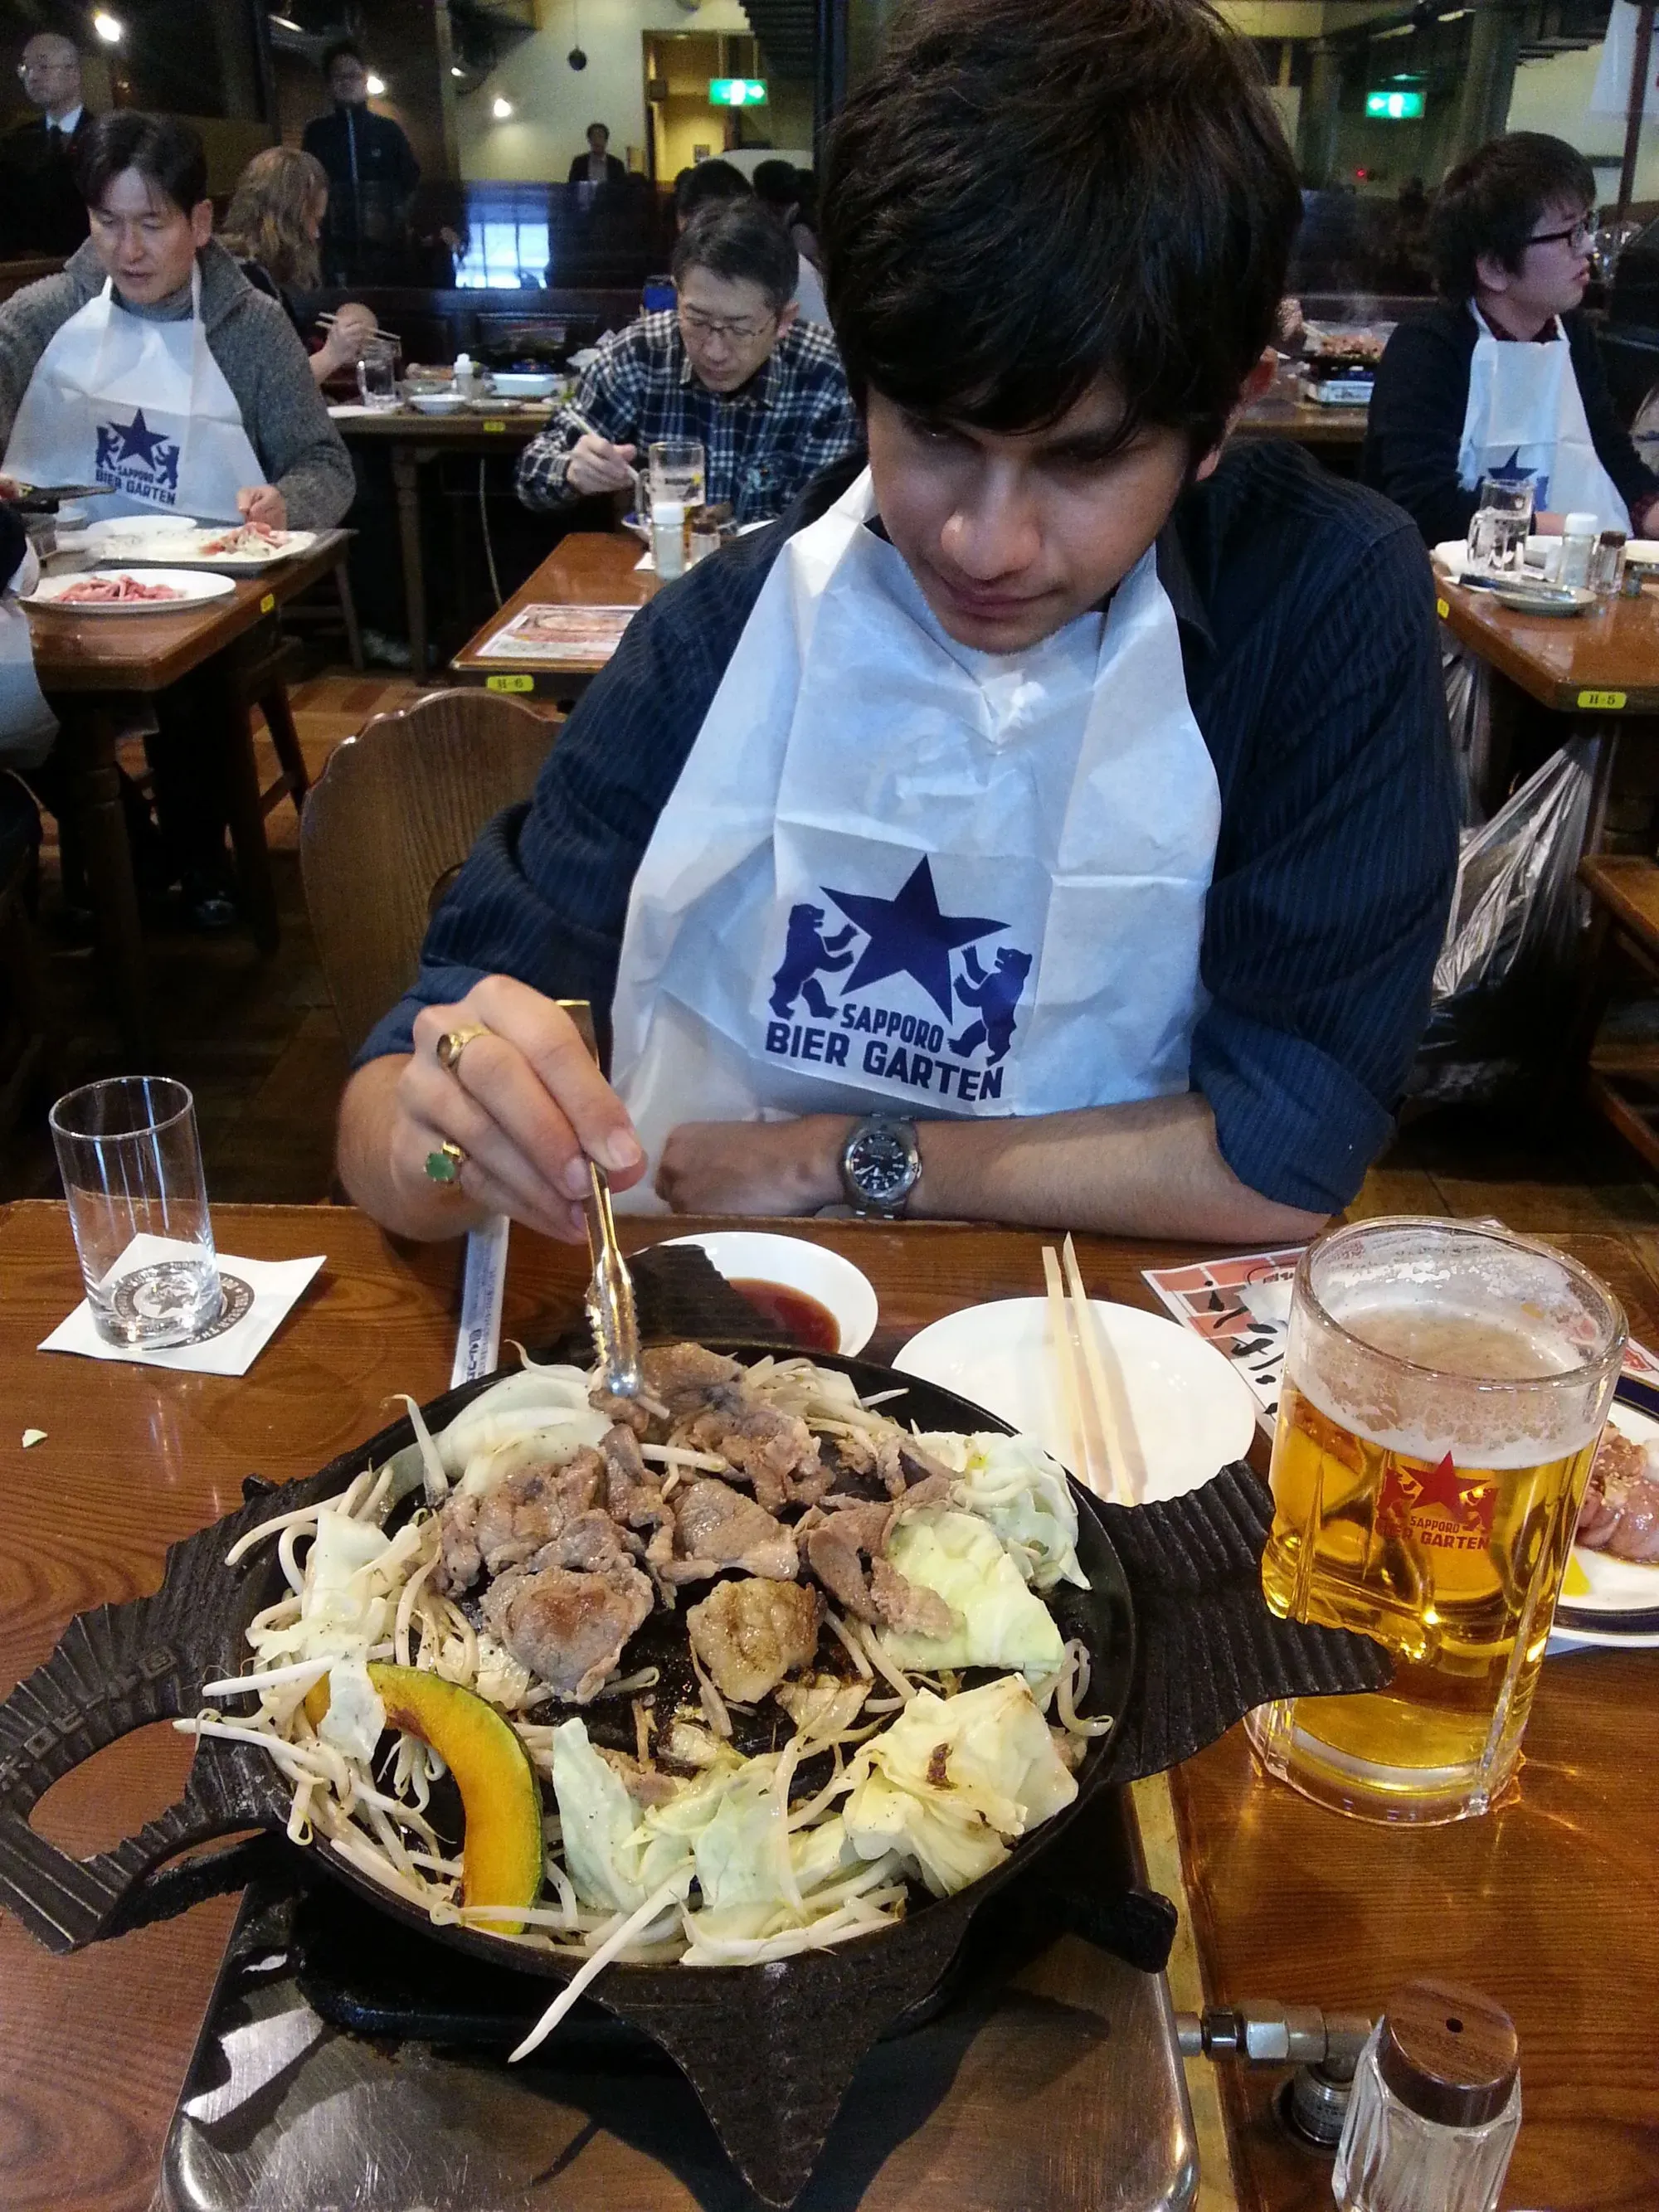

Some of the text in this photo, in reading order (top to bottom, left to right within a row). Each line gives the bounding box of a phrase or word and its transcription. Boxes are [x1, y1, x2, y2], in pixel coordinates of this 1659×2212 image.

[126, 479, 177, 506] GARTEN
[840, 1003, 945, 1054] SAPPORO
[765, 1021, 1005, 1102] BIER GARTEN
[1409, 1515, 1461, 1534] SAPPORO
[1419, 1530, 1491, 1550] GARTEN
